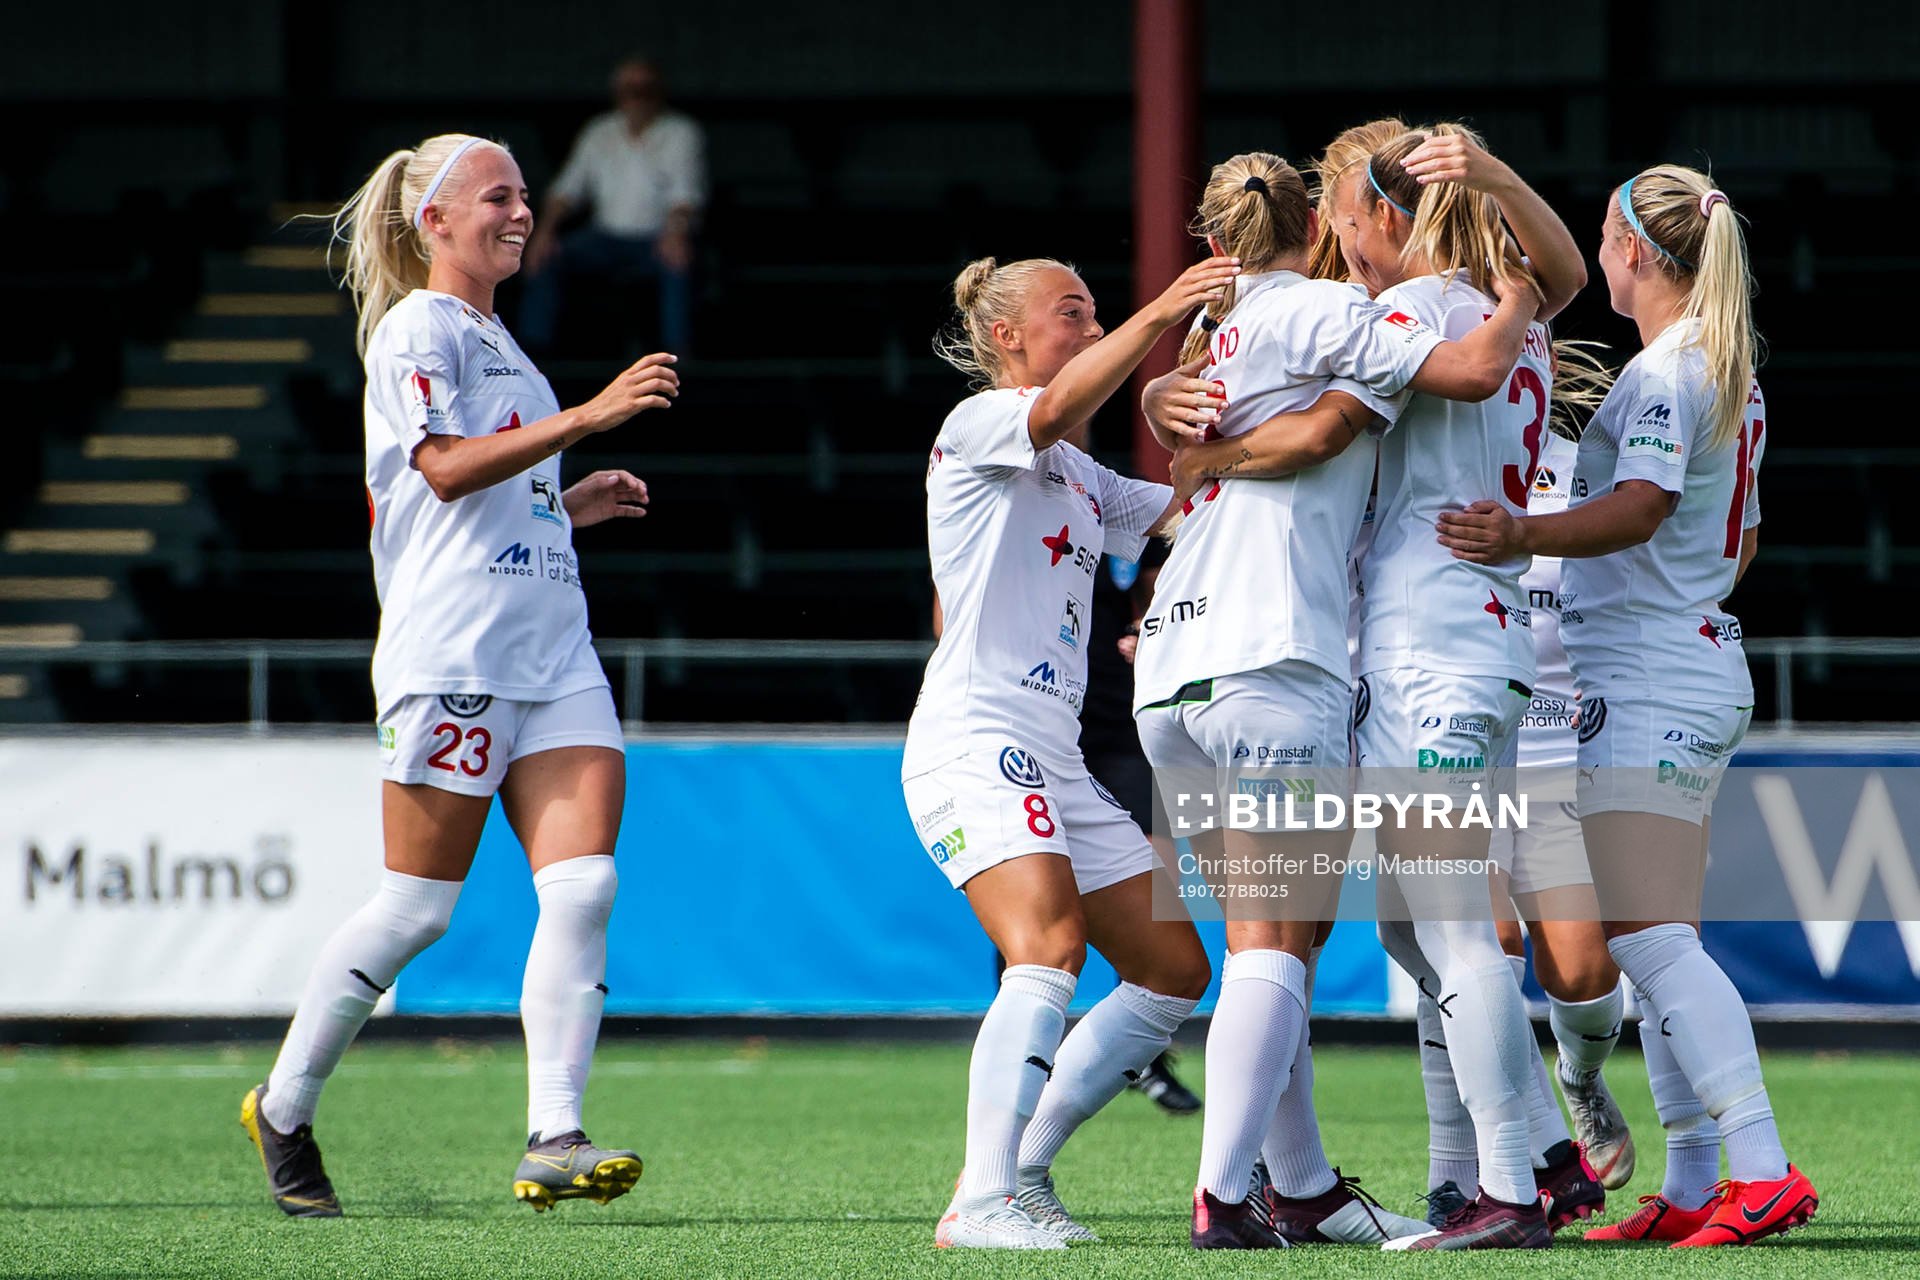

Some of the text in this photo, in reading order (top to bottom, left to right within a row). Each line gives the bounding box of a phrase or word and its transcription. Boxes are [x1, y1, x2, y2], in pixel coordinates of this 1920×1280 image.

[1503, 366, 1546, 510] 3
[1628, 436, 1675, 453] PEAB
[488, 566, 535, 577] MIDROC
[1020, 678, 1061, 698] MIDROC
[1527, 698, 1567, 714] assy
[427, 722, 492, 777] 23
[1257, 745, 1317, 759] Damstahl
[920, 796, 955, 828] Damstahl
[1024, 793, 1056, 838] 8
[24, 833, 296, 903] Malmö
